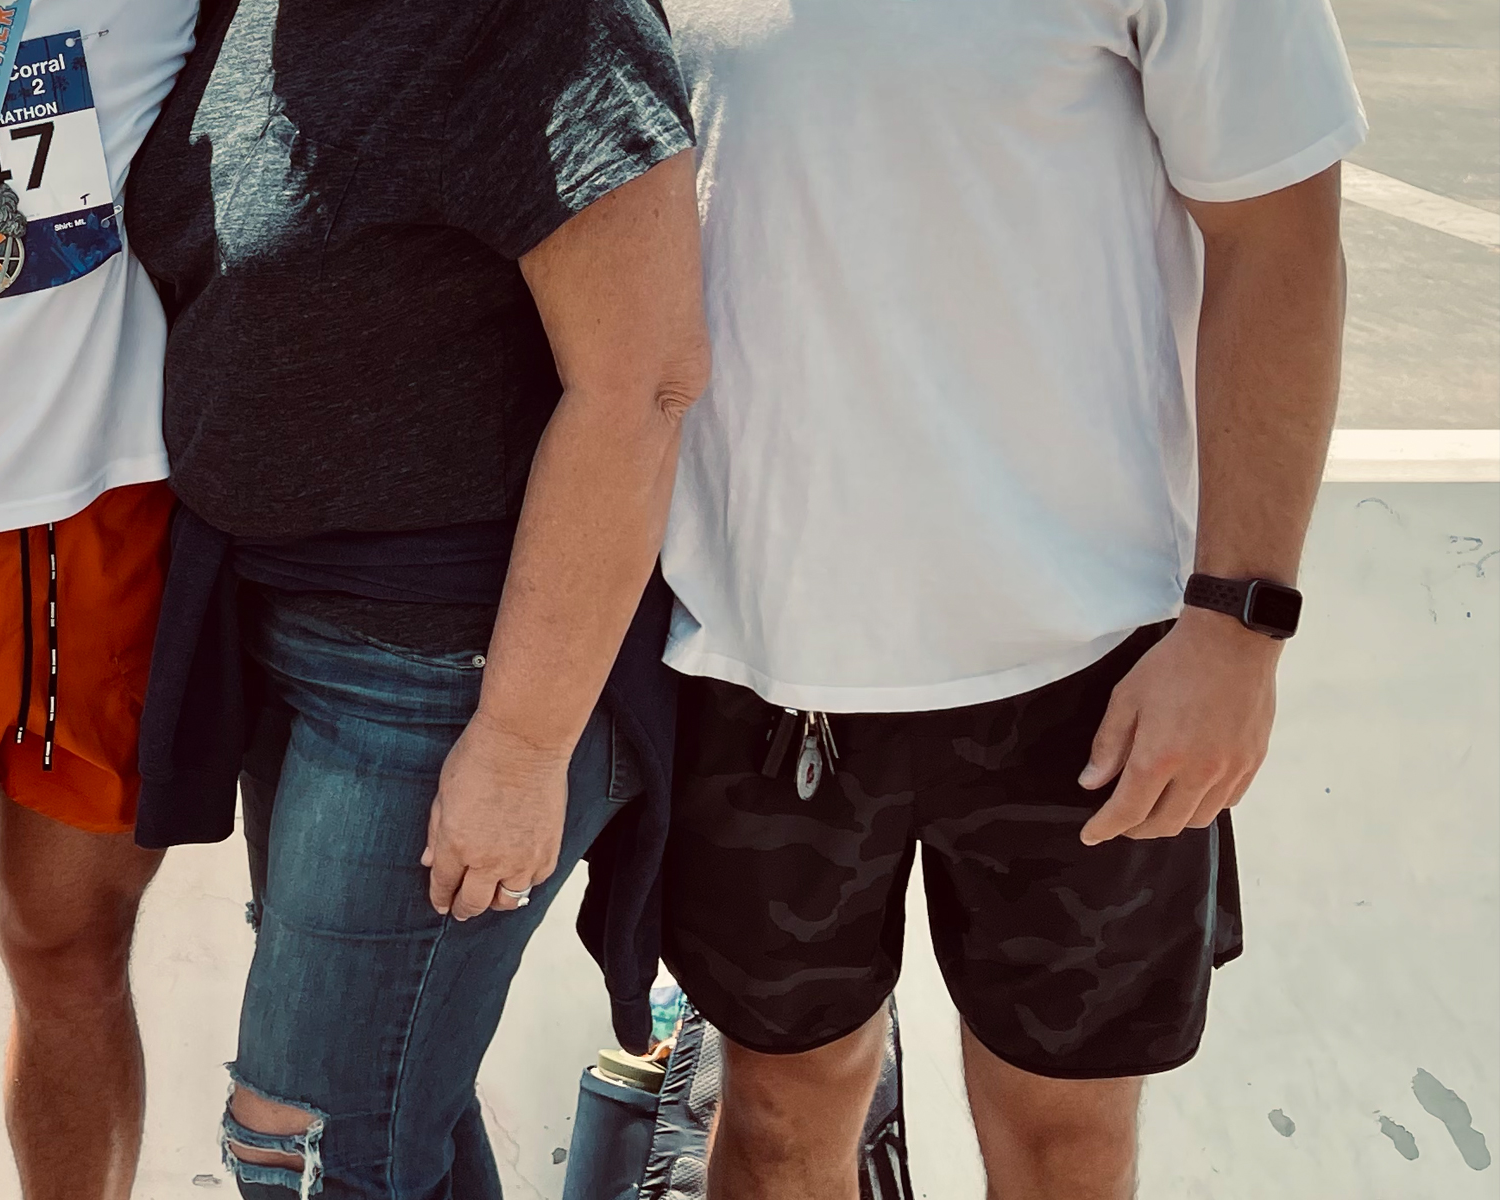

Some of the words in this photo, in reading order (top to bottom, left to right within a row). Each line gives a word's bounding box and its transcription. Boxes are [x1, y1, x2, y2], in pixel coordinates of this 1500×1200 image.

[10, 53, 66, 81] Corral
[31, 78, 46, 96] 2
[54, 222, 73, 232] Shirt:
